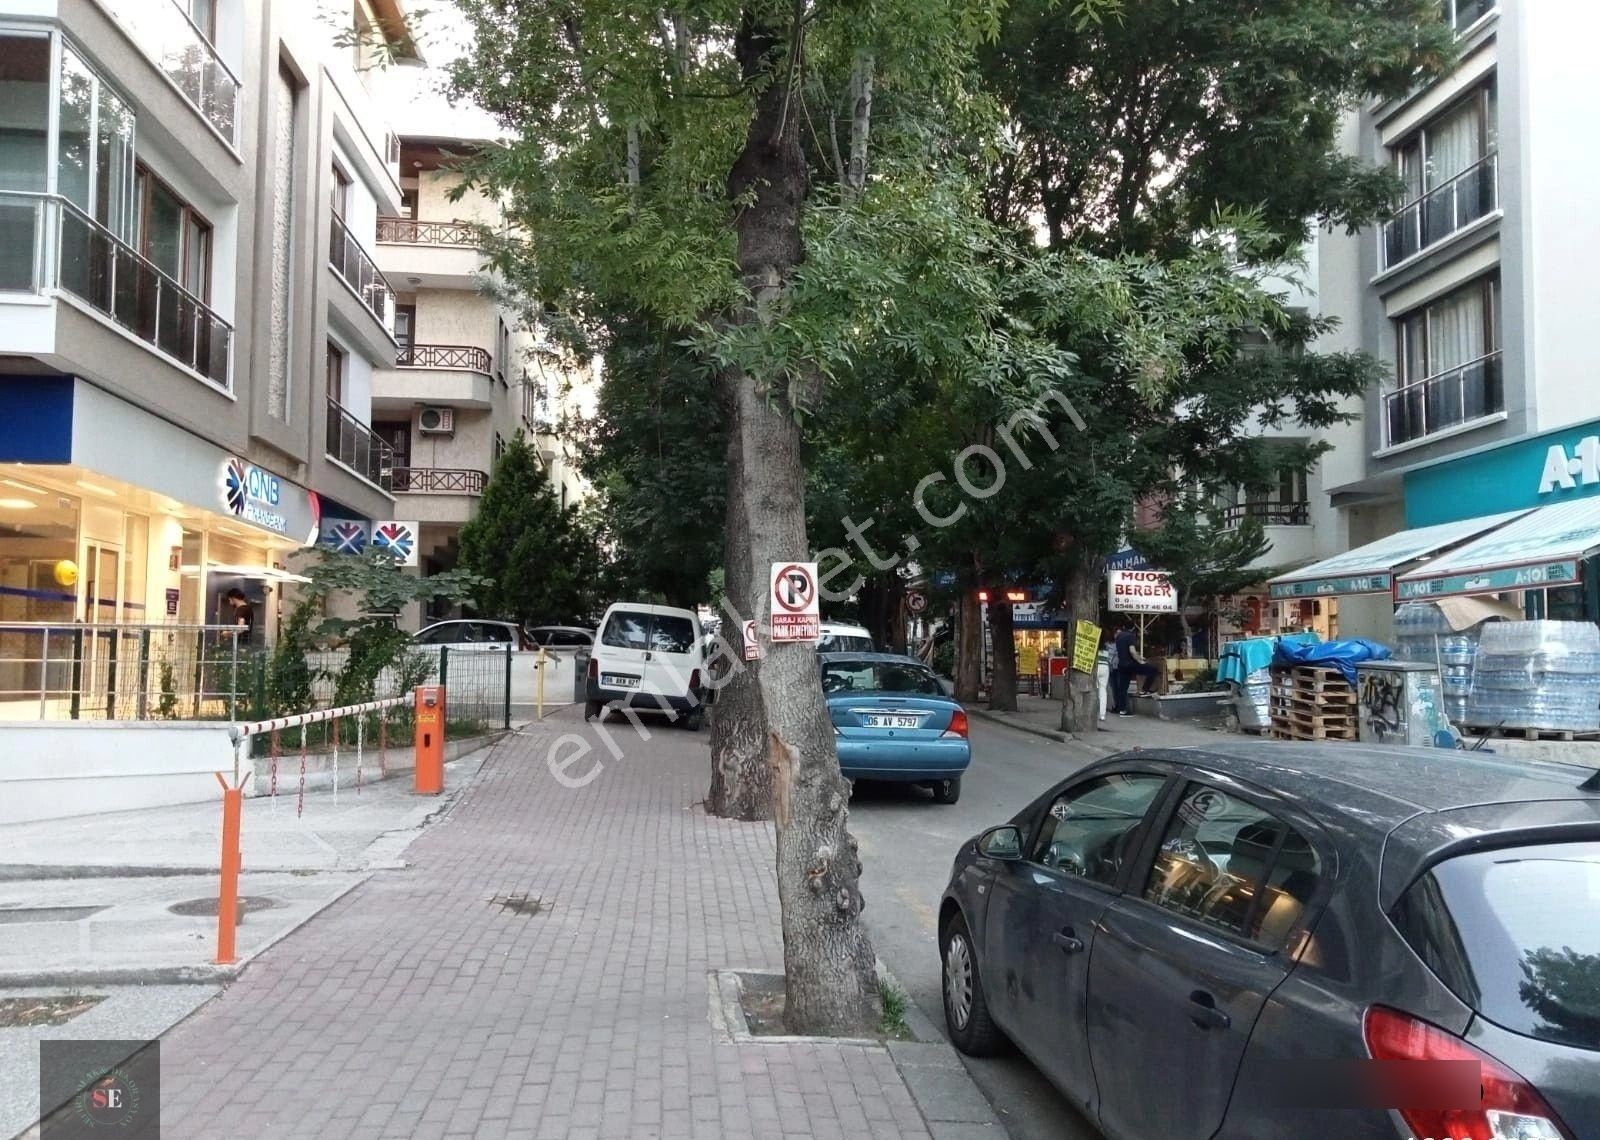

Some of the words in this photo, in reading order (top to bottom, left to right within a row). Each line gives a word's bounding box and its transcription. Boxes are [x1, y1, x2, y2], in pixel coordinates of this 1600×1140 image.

[250, 469, 279, 505] QNB
[1114, 584, 1171, 598] BERBER
[774, 624, 789, 638] PARK
[868, 716, 879, 726] 06
[883, 717, 893, 727] AV
[897, 717, 917, 728] 5797
